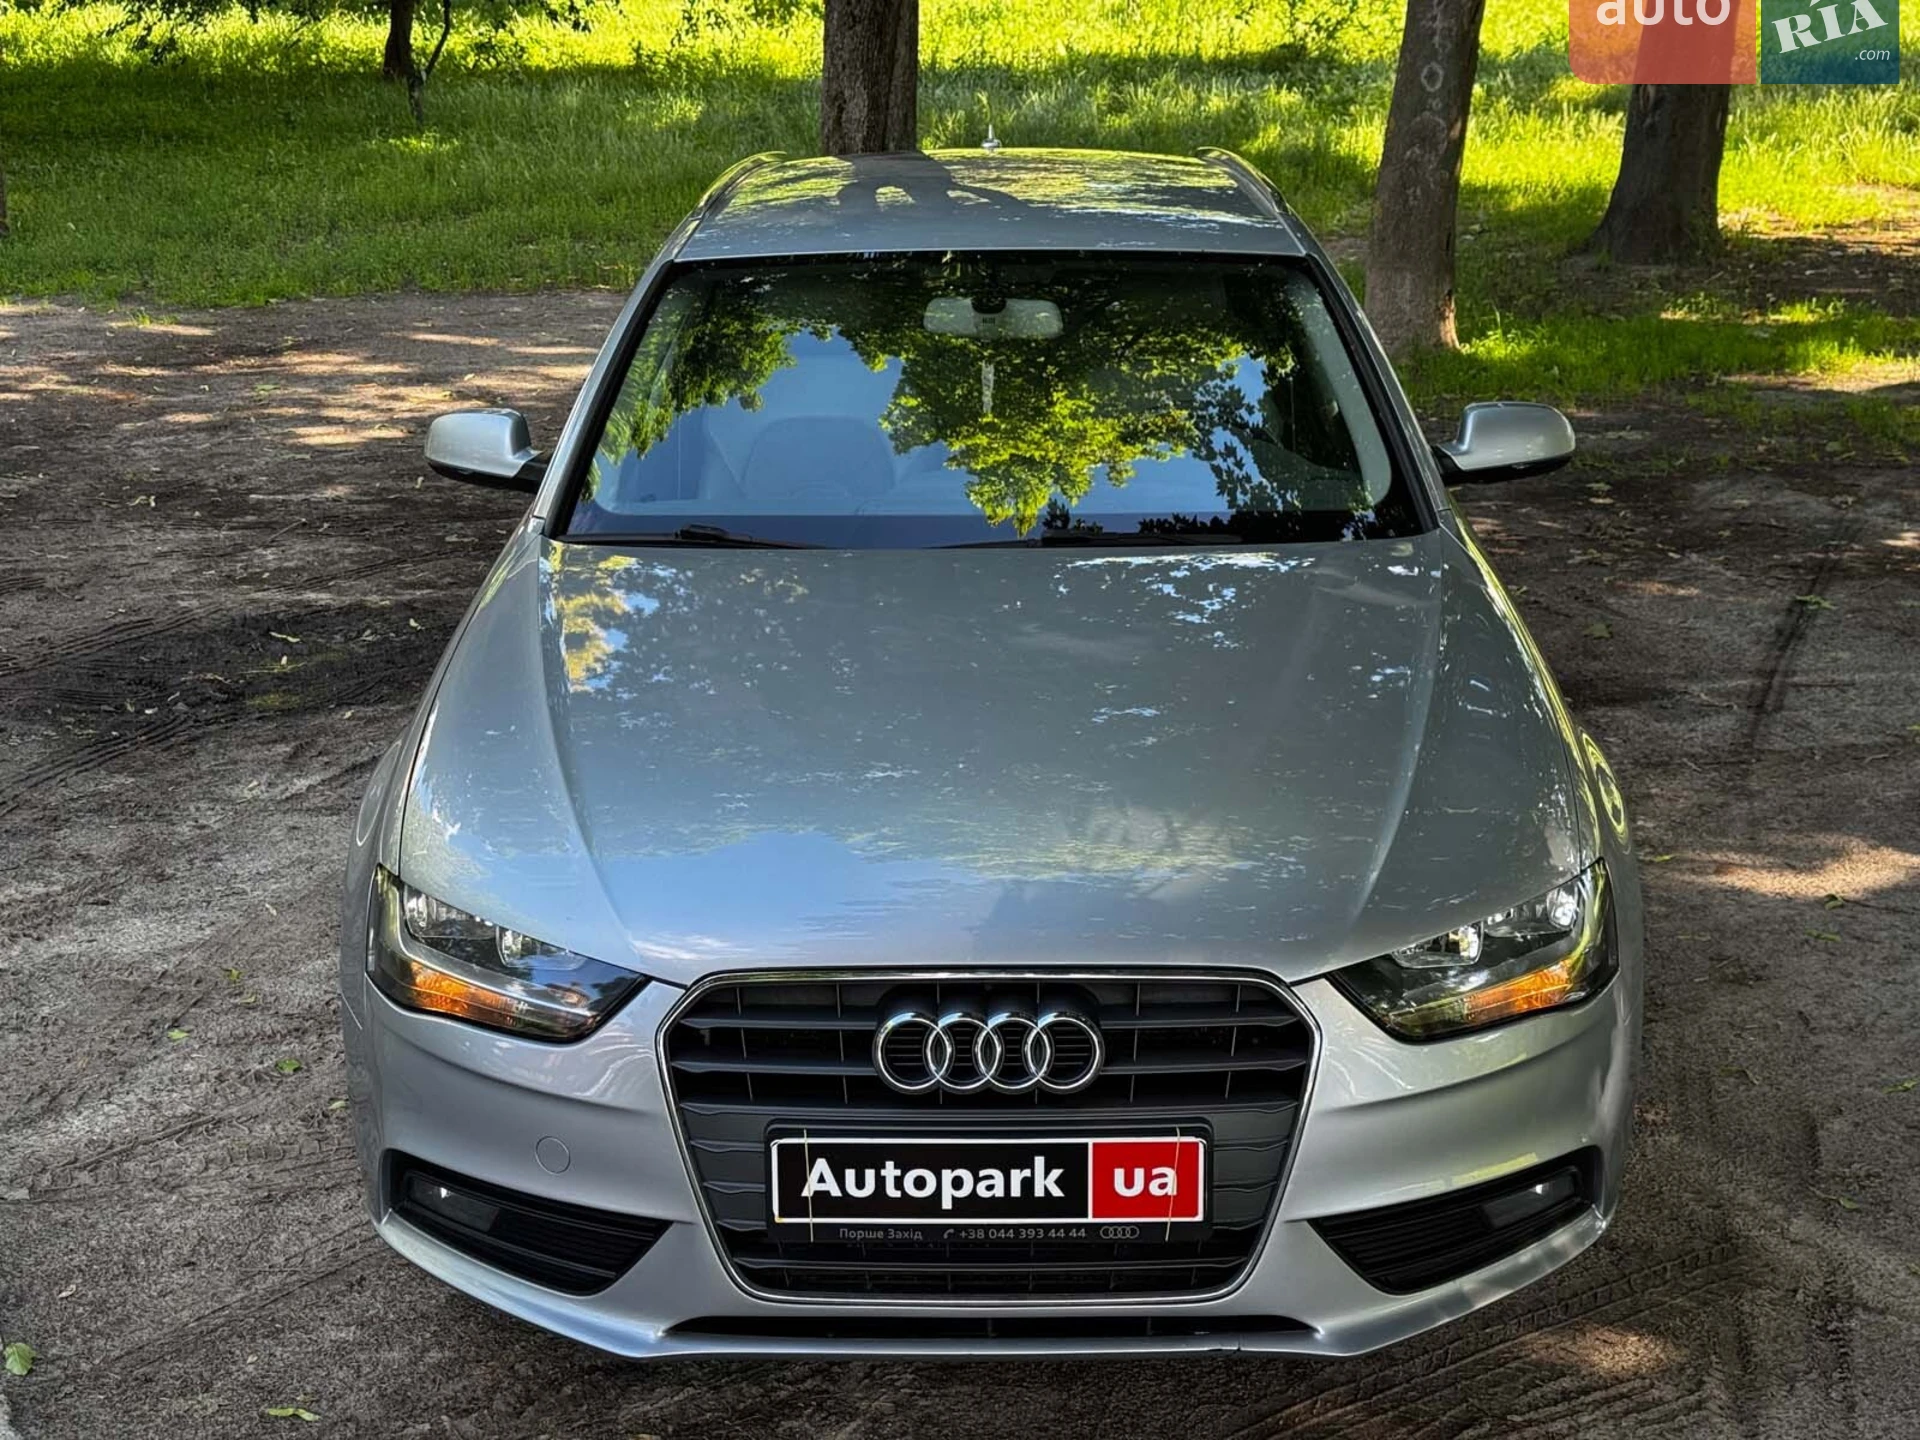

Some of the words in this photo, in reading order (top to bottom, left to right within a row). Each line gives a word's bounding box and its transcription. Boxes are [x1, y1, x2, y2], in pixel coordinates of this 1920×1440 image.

[800, 1156, 1066, 1210] Autopark
[1113, 1166, 1178, 1197] ua
[839, 1228, 884, 1241] Порше
[887, 1228, 923, 1241] Захід
[959, 1228, 985, 1239] +38
[988, 1228, 1015, 1239] 044
[1018, 1228, 1044, 1239] 393
[1047, 1228, 1066, 1239] 44
[1068, 1228, 1087, 1239] 44
